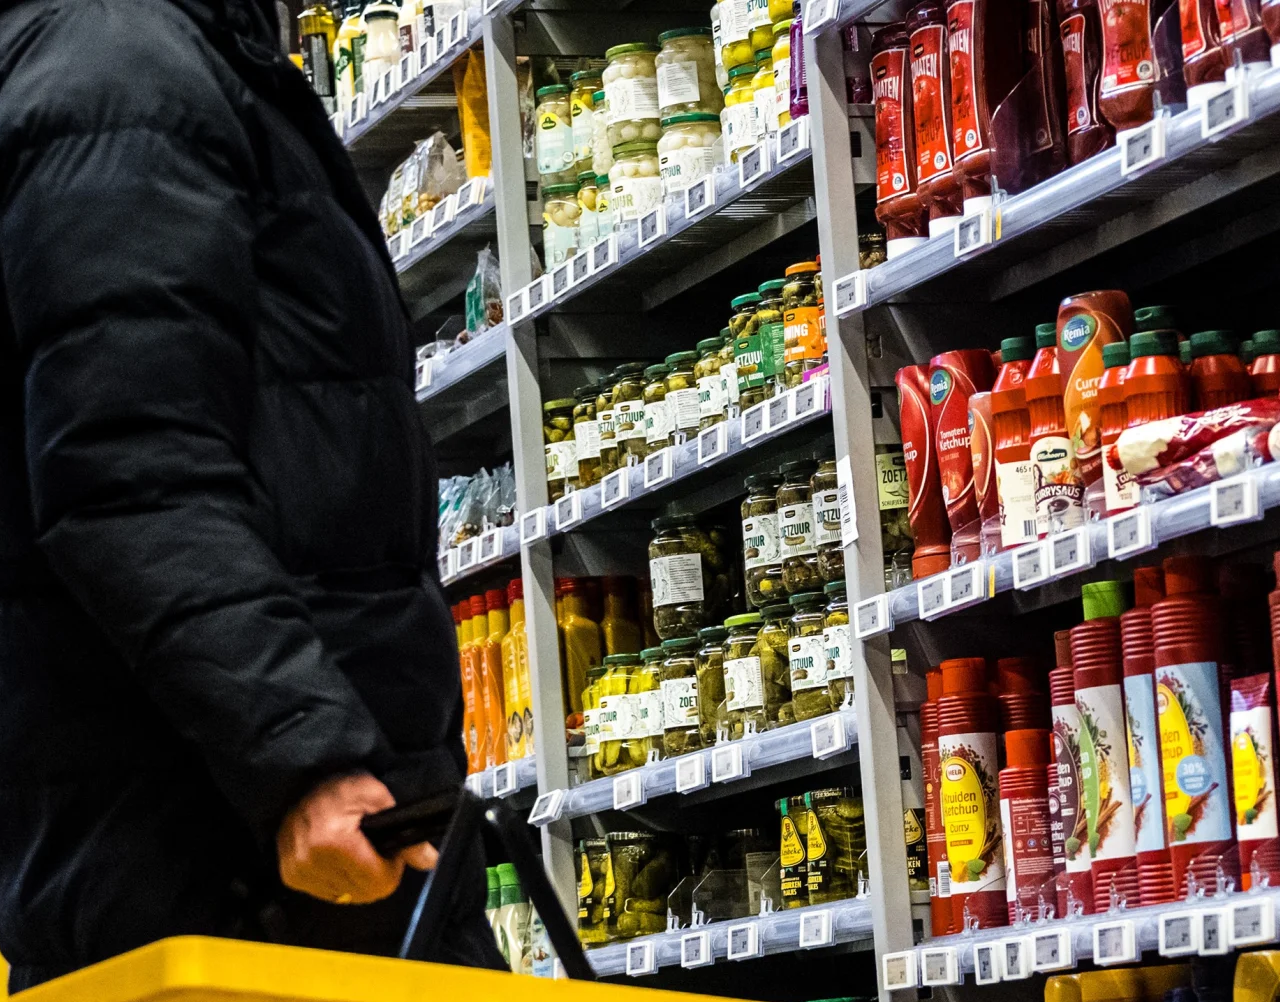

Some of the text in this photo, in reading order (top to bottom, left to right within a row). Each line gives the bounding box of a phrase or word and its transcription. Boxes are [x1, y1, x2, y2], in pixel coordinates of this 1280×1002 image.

[1063, 323, 1091, 342] Remia
[940, 426, 967, 438] Tomaten
[939, 436, 971, 452] Ketchup
[1035, 484, 1081, 500] CURRYSAUS
[1183, 763, 1205, 775] 30%
[943, 791, 977, 804] Kruiden
[944, 803, 979, 817] Ketchup
[949, 823, 970, 833] Curry
